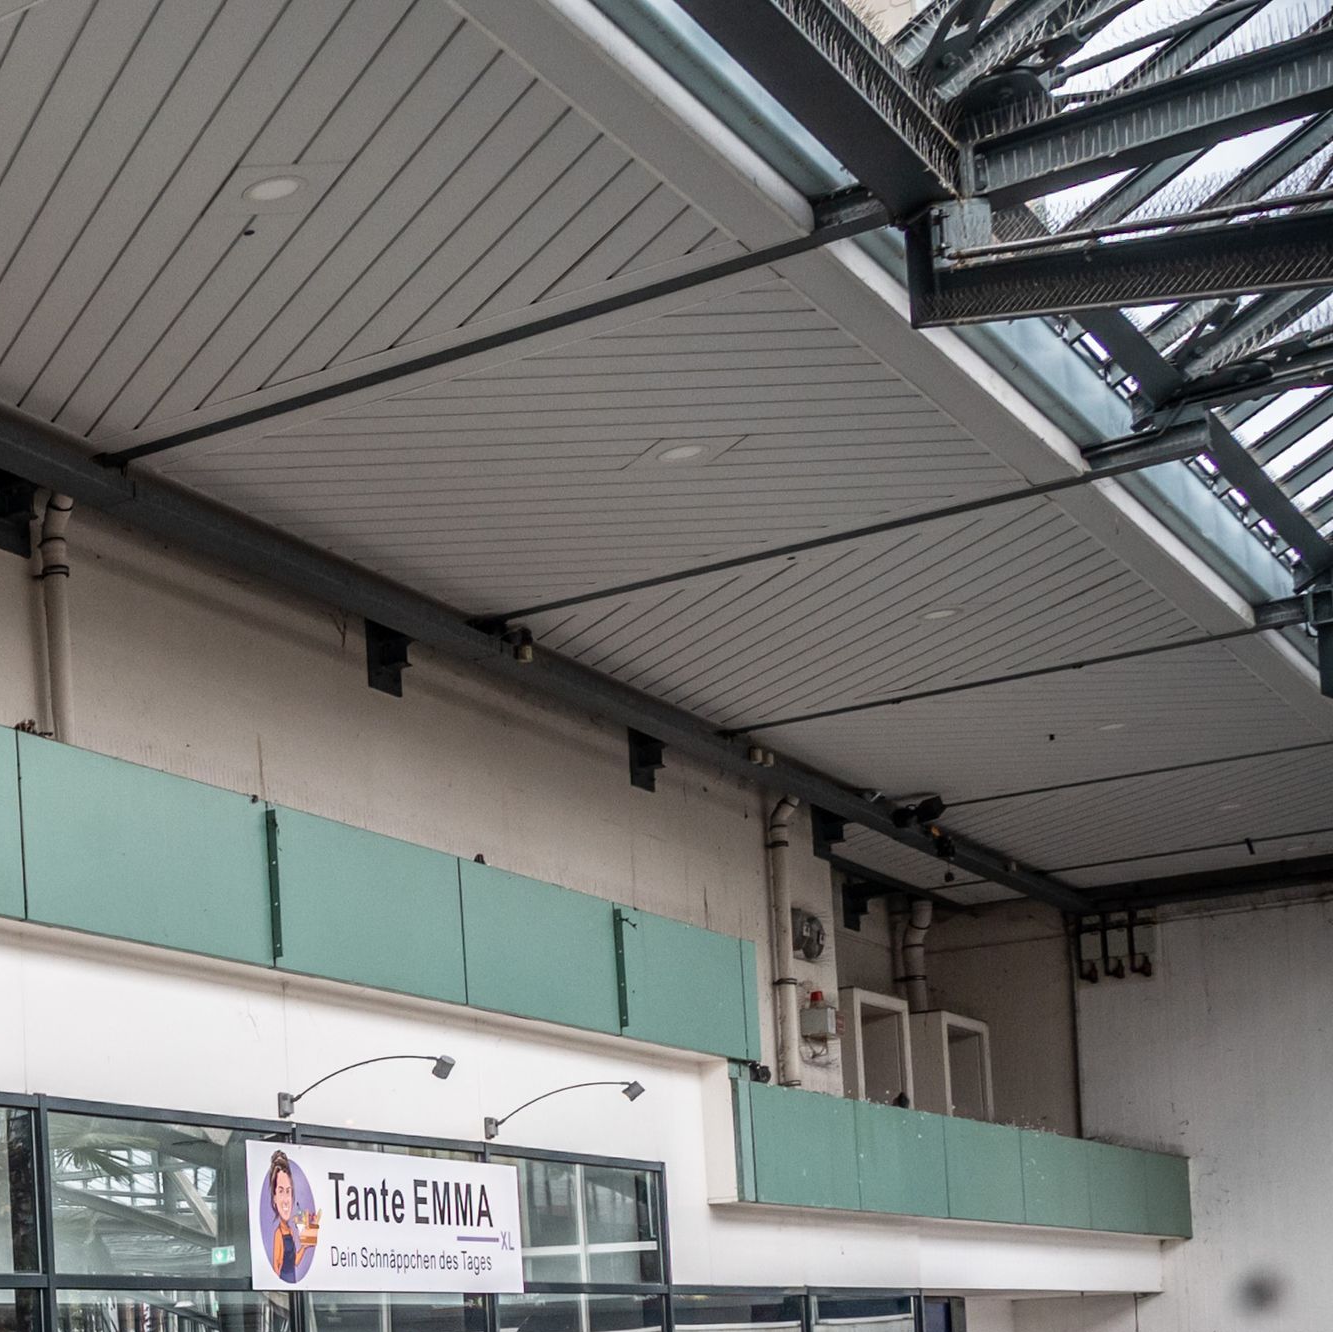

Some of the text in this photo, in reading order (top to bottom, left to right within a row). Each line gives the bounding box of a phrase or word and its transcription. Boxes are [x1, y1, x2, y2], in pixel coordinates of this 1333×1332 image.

[328, 1172, 494, 1228] Tante EMMA
[500, 1231, 515, 1251] XL
[331, 1246, 493, 1276] Dein Schnäppchen des Tages
